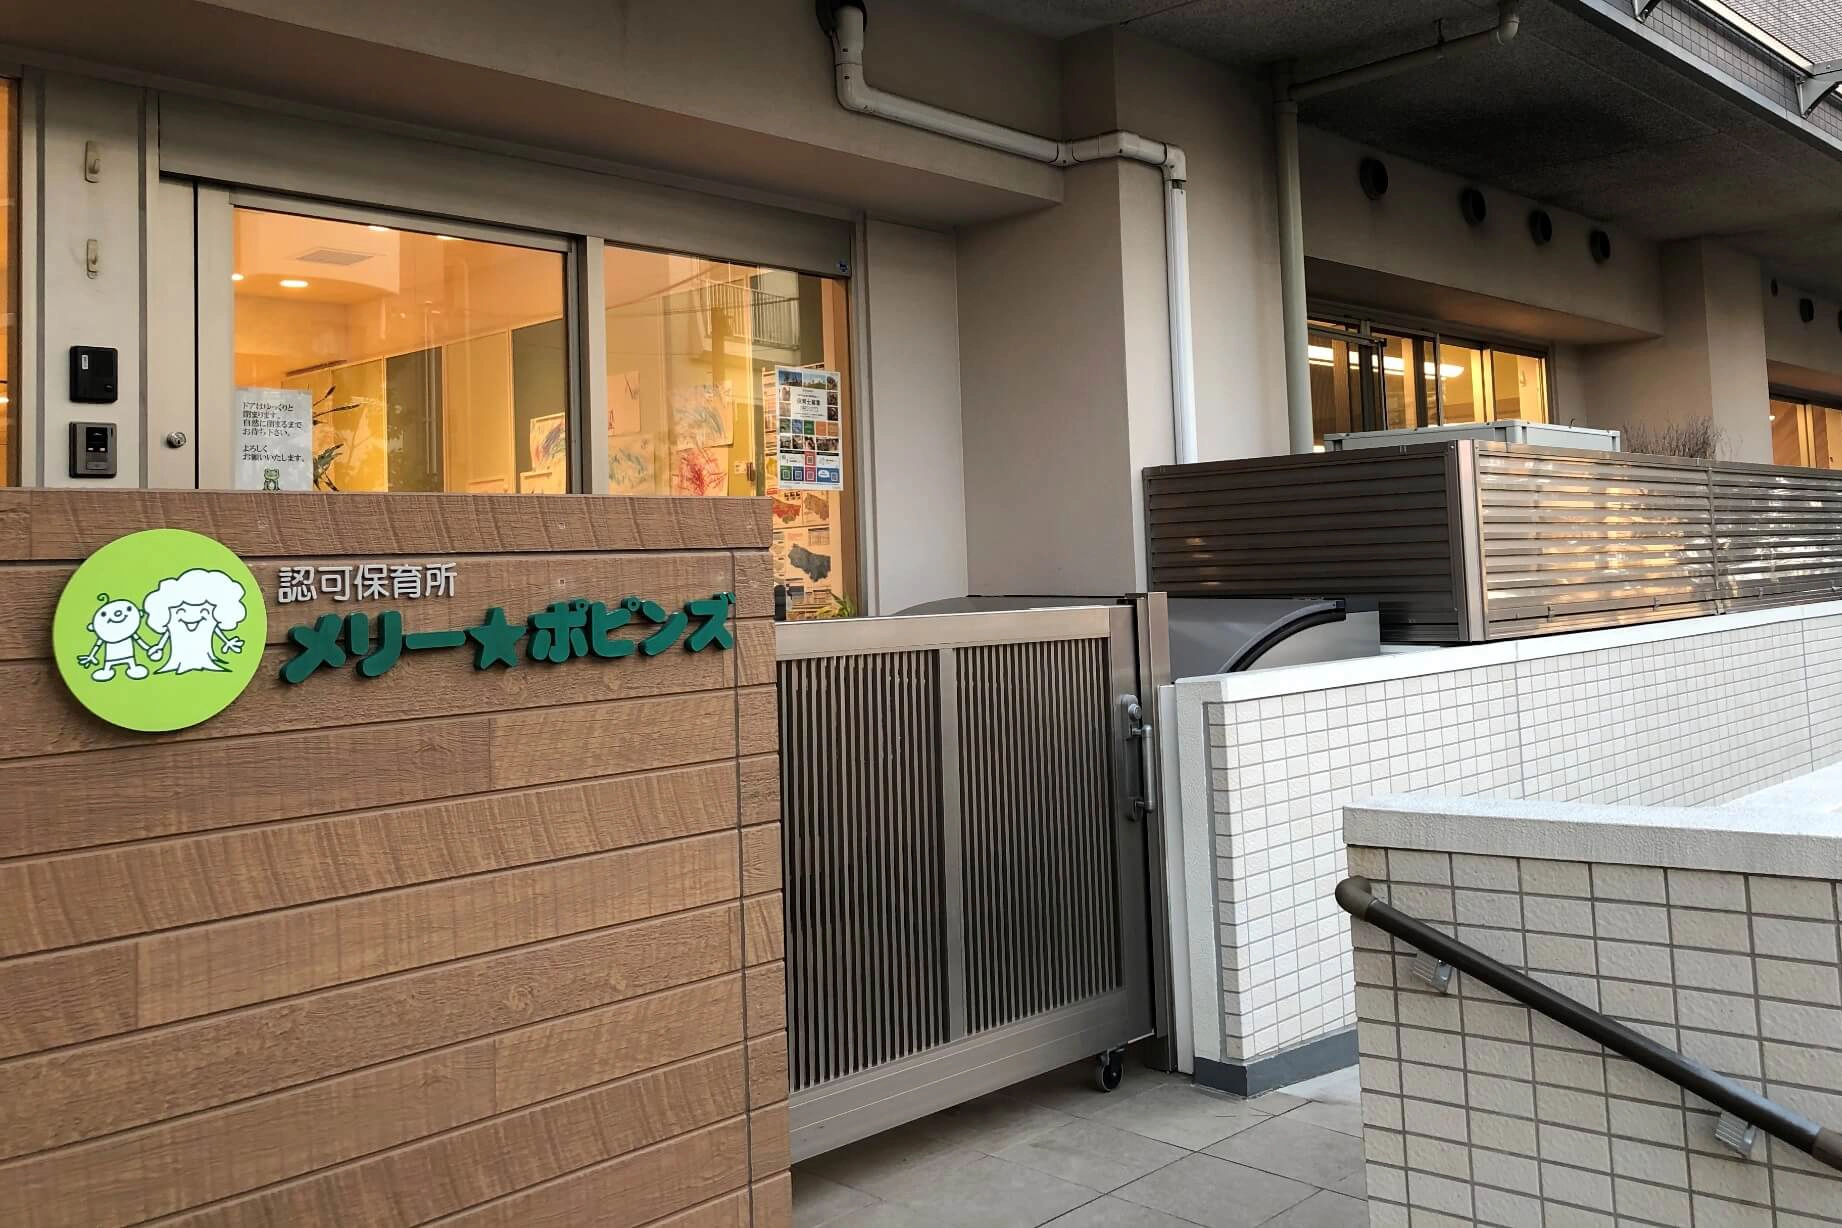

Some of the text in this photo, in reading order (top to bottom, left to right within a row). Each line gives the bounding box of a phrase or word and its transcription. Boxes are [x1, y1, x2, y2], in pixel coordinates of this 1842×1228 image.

[243, 444, 268, 453] よろしく
[278, 562, 458, 604] 認可保育所
